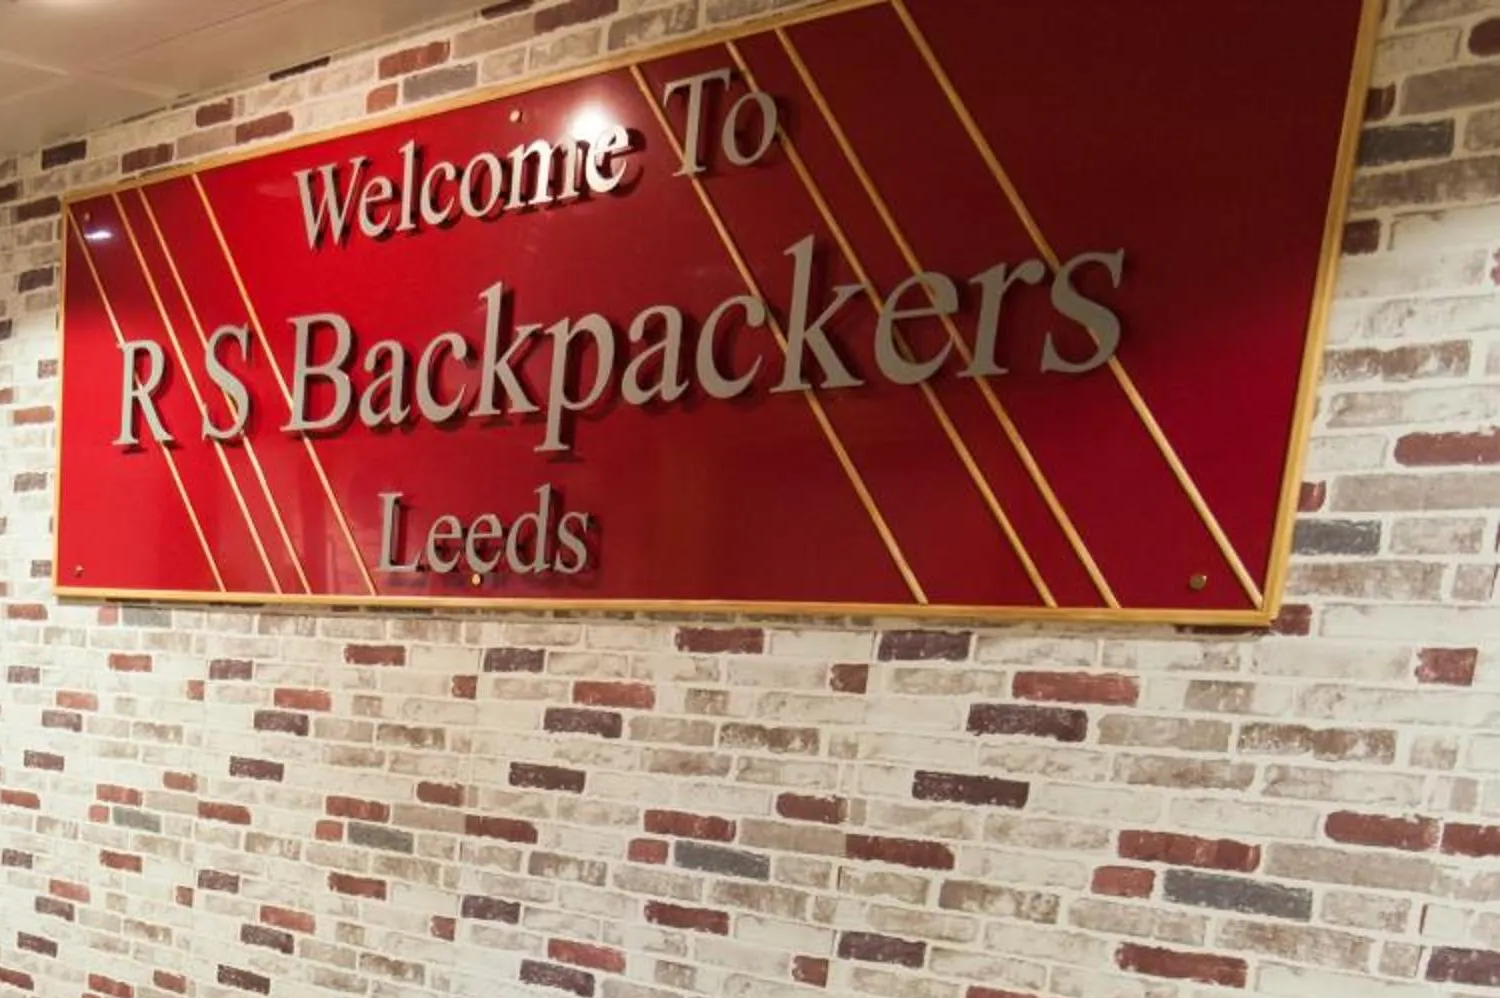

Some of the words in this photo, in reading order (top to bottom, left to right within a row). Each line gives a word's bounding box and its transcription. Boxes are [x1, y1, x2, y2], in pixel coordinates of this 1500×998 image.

[295, 118, 632, 251] Welcome
[662, 65, 779, 178] To
[280, 234, 1126, 453] Backpackers
[376, 482, 590, 575] Leeds
